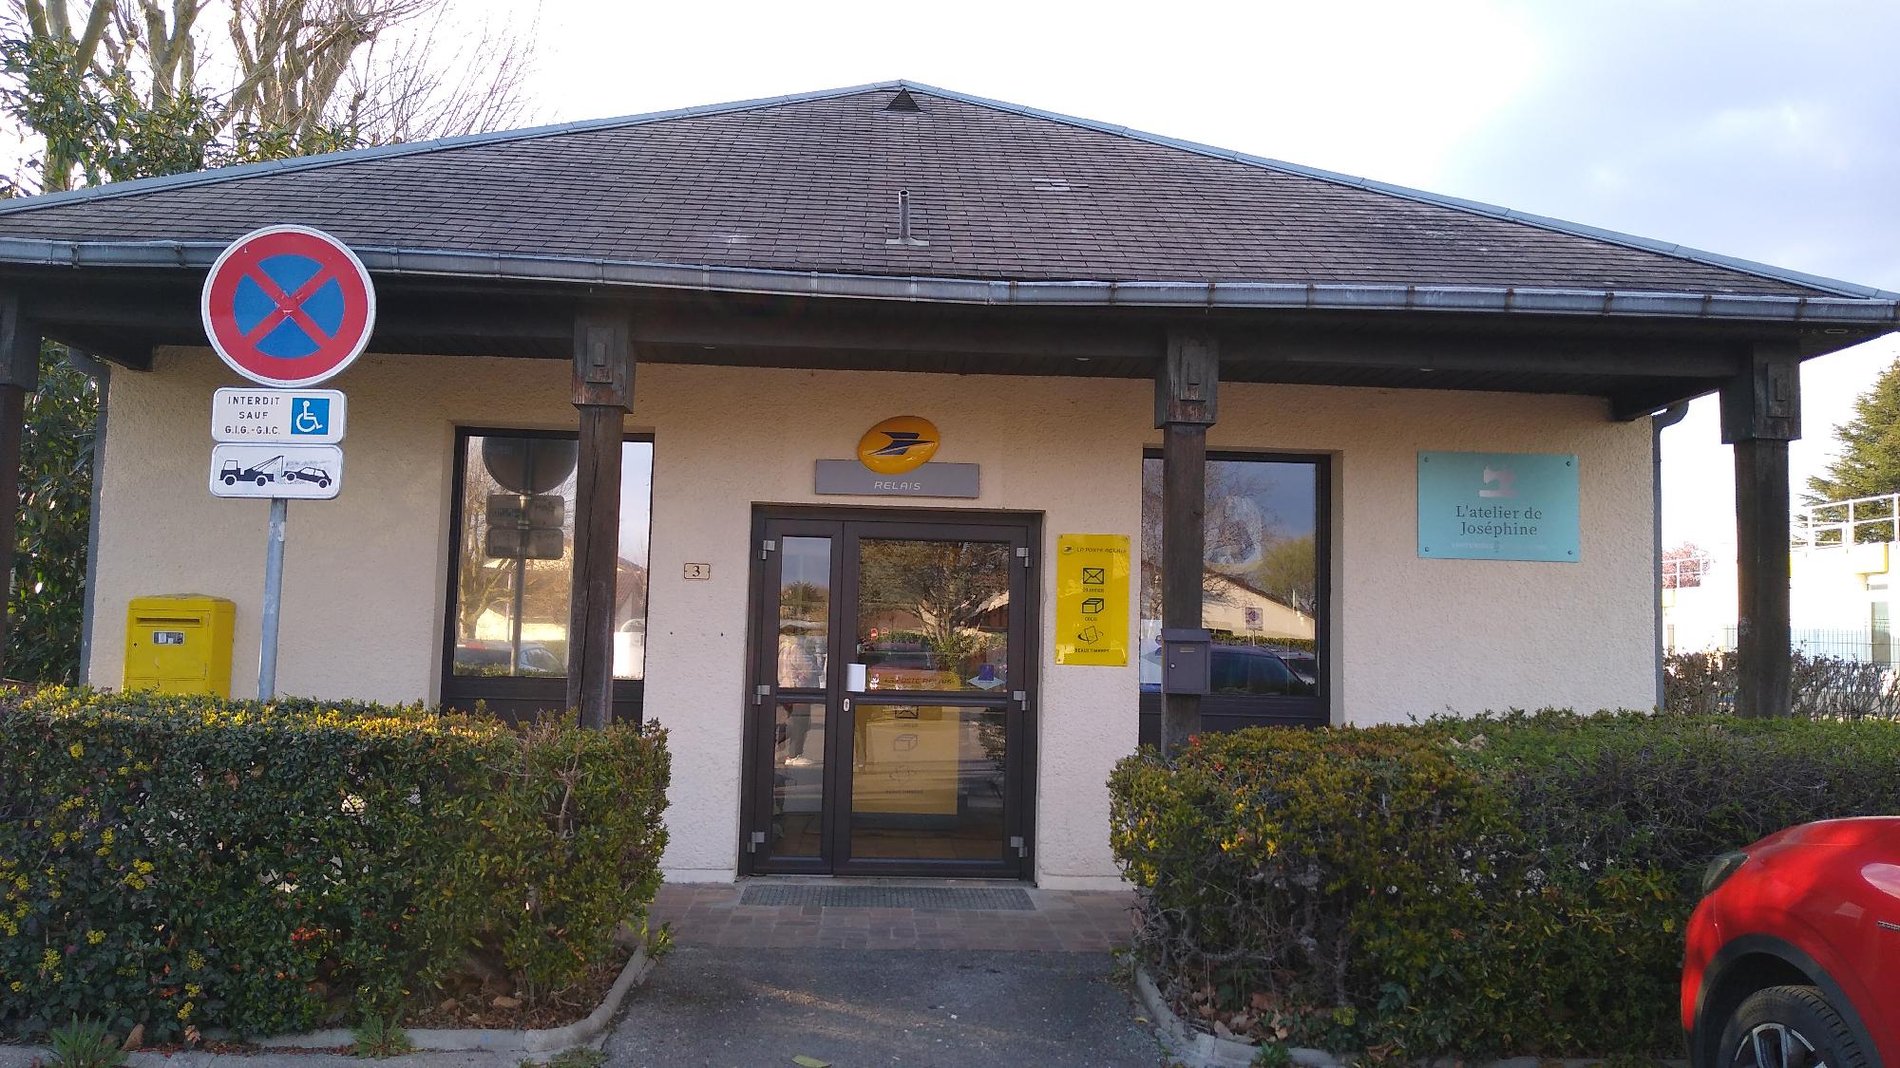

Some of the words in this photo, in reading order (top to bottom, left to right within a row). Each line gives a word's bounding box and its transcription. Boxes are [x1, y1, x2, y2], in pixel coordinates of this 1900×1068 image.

[228, 396, 280, 406] INTERDIT
[238, 411, 269, 420] SAUF
[874, 480, 921, 491] RELAIS
[1455, 505, 1520, 519] L'atelier
[1524, 506, 1543, 520] de
[1459, 521, 1538, 538] Joséphine
[692, 565, 701, 577] 3
